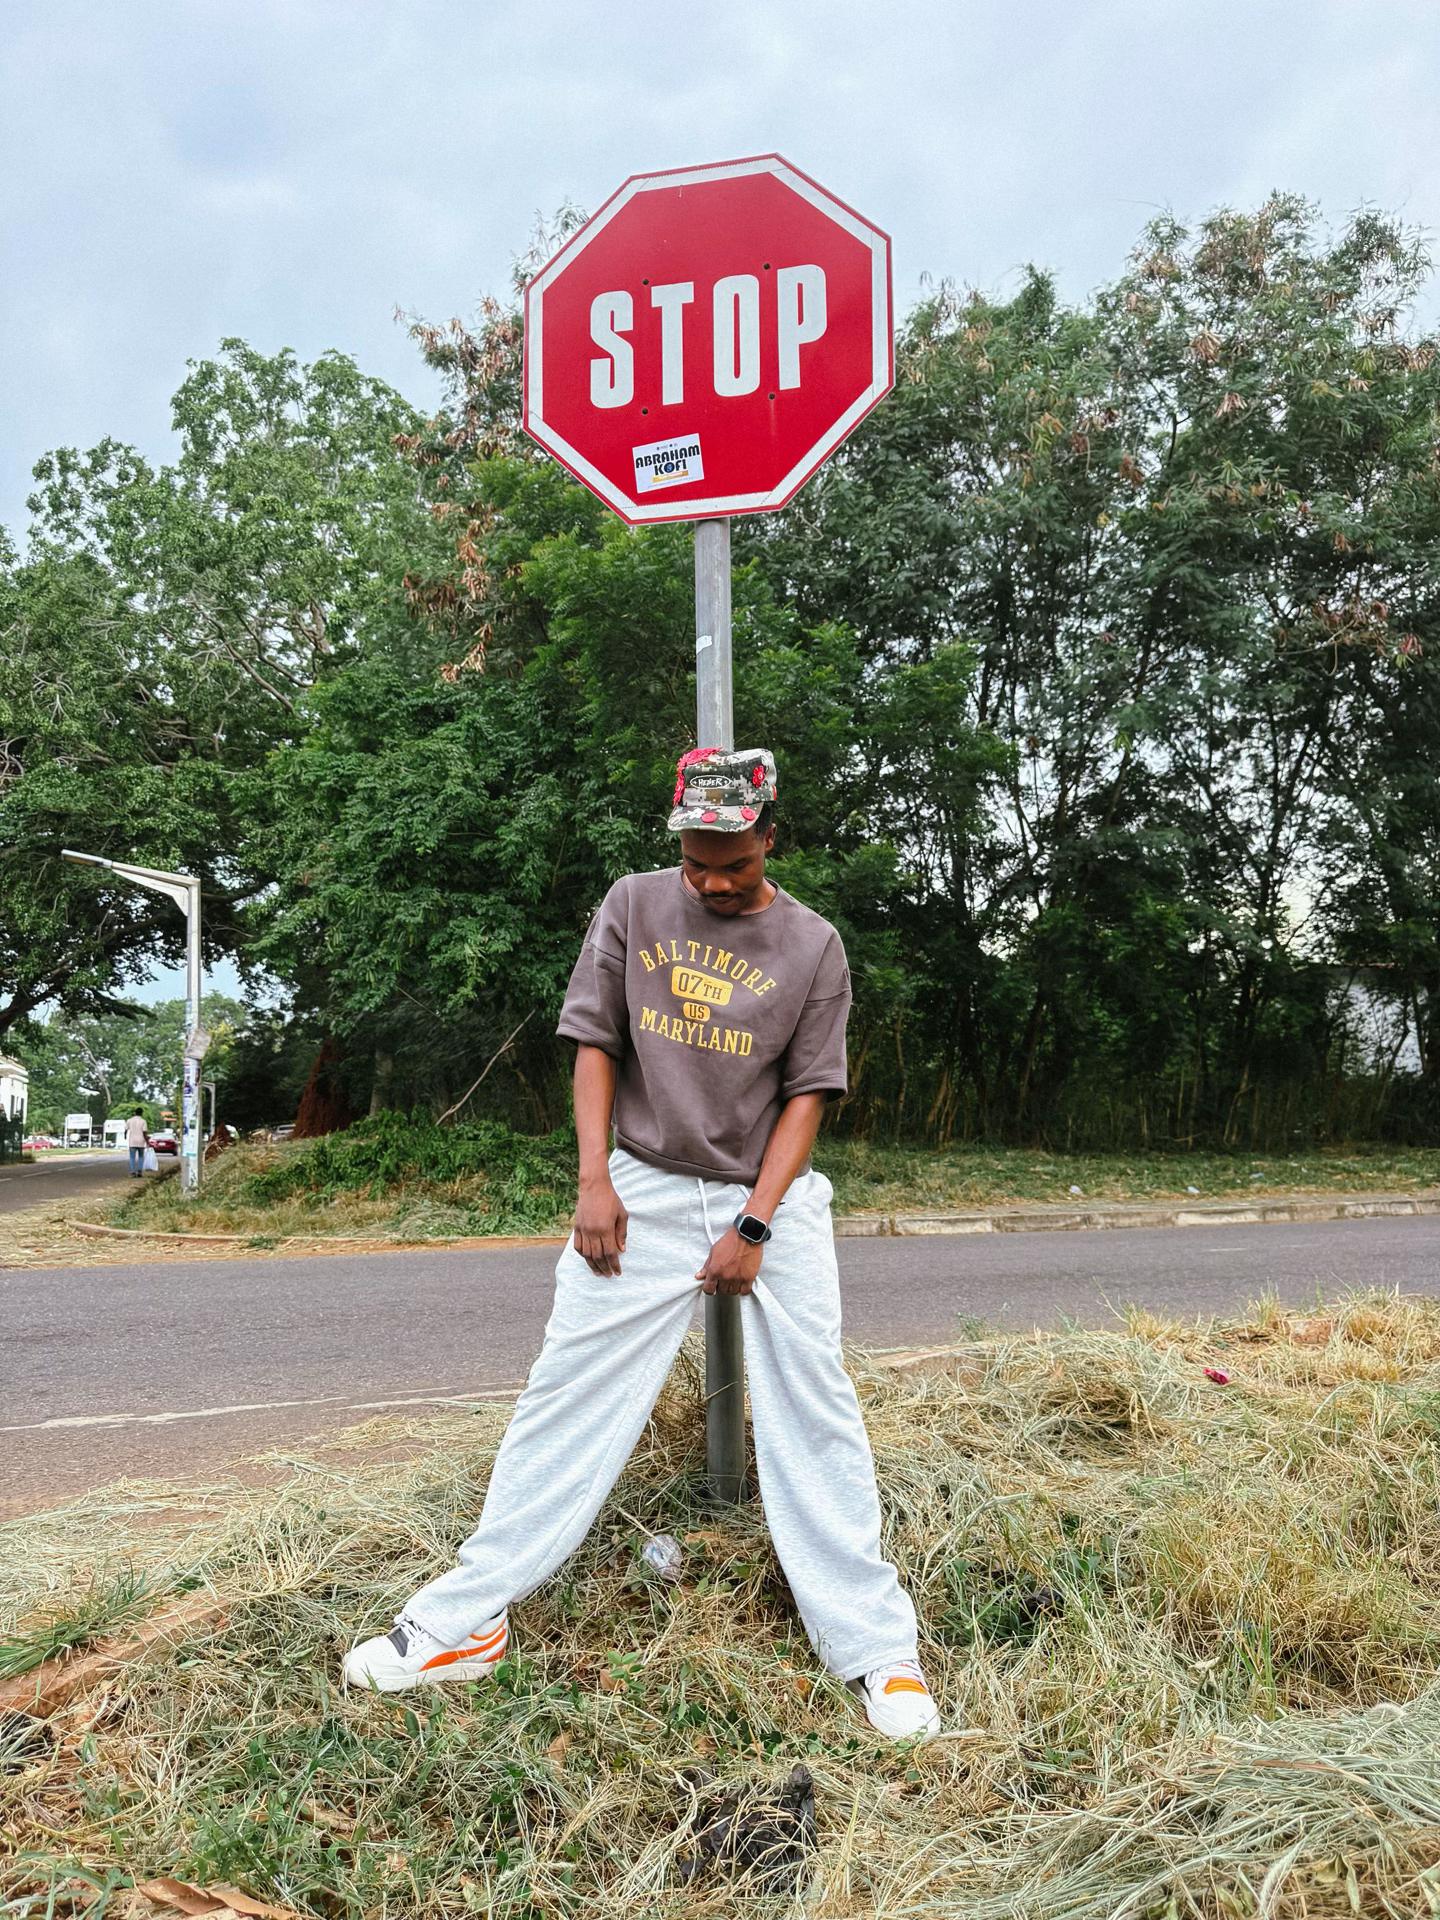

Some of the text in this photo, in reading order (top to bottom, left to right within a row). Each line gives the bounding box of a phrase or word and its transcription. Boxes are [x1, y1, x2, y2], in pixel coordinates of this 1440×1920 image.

[590, 264, 828, 409] STOP
[635, 444, 700, 469] ABRAHAM
[654, 459, 687, 476] KOFI
[639, 939, 777, 997] BALTIMORE
[678, 972, 723, 1000] 07TH
[689, 1004, 705, 1020] US
[639, 1006, 753, 1056] MARYLAND
